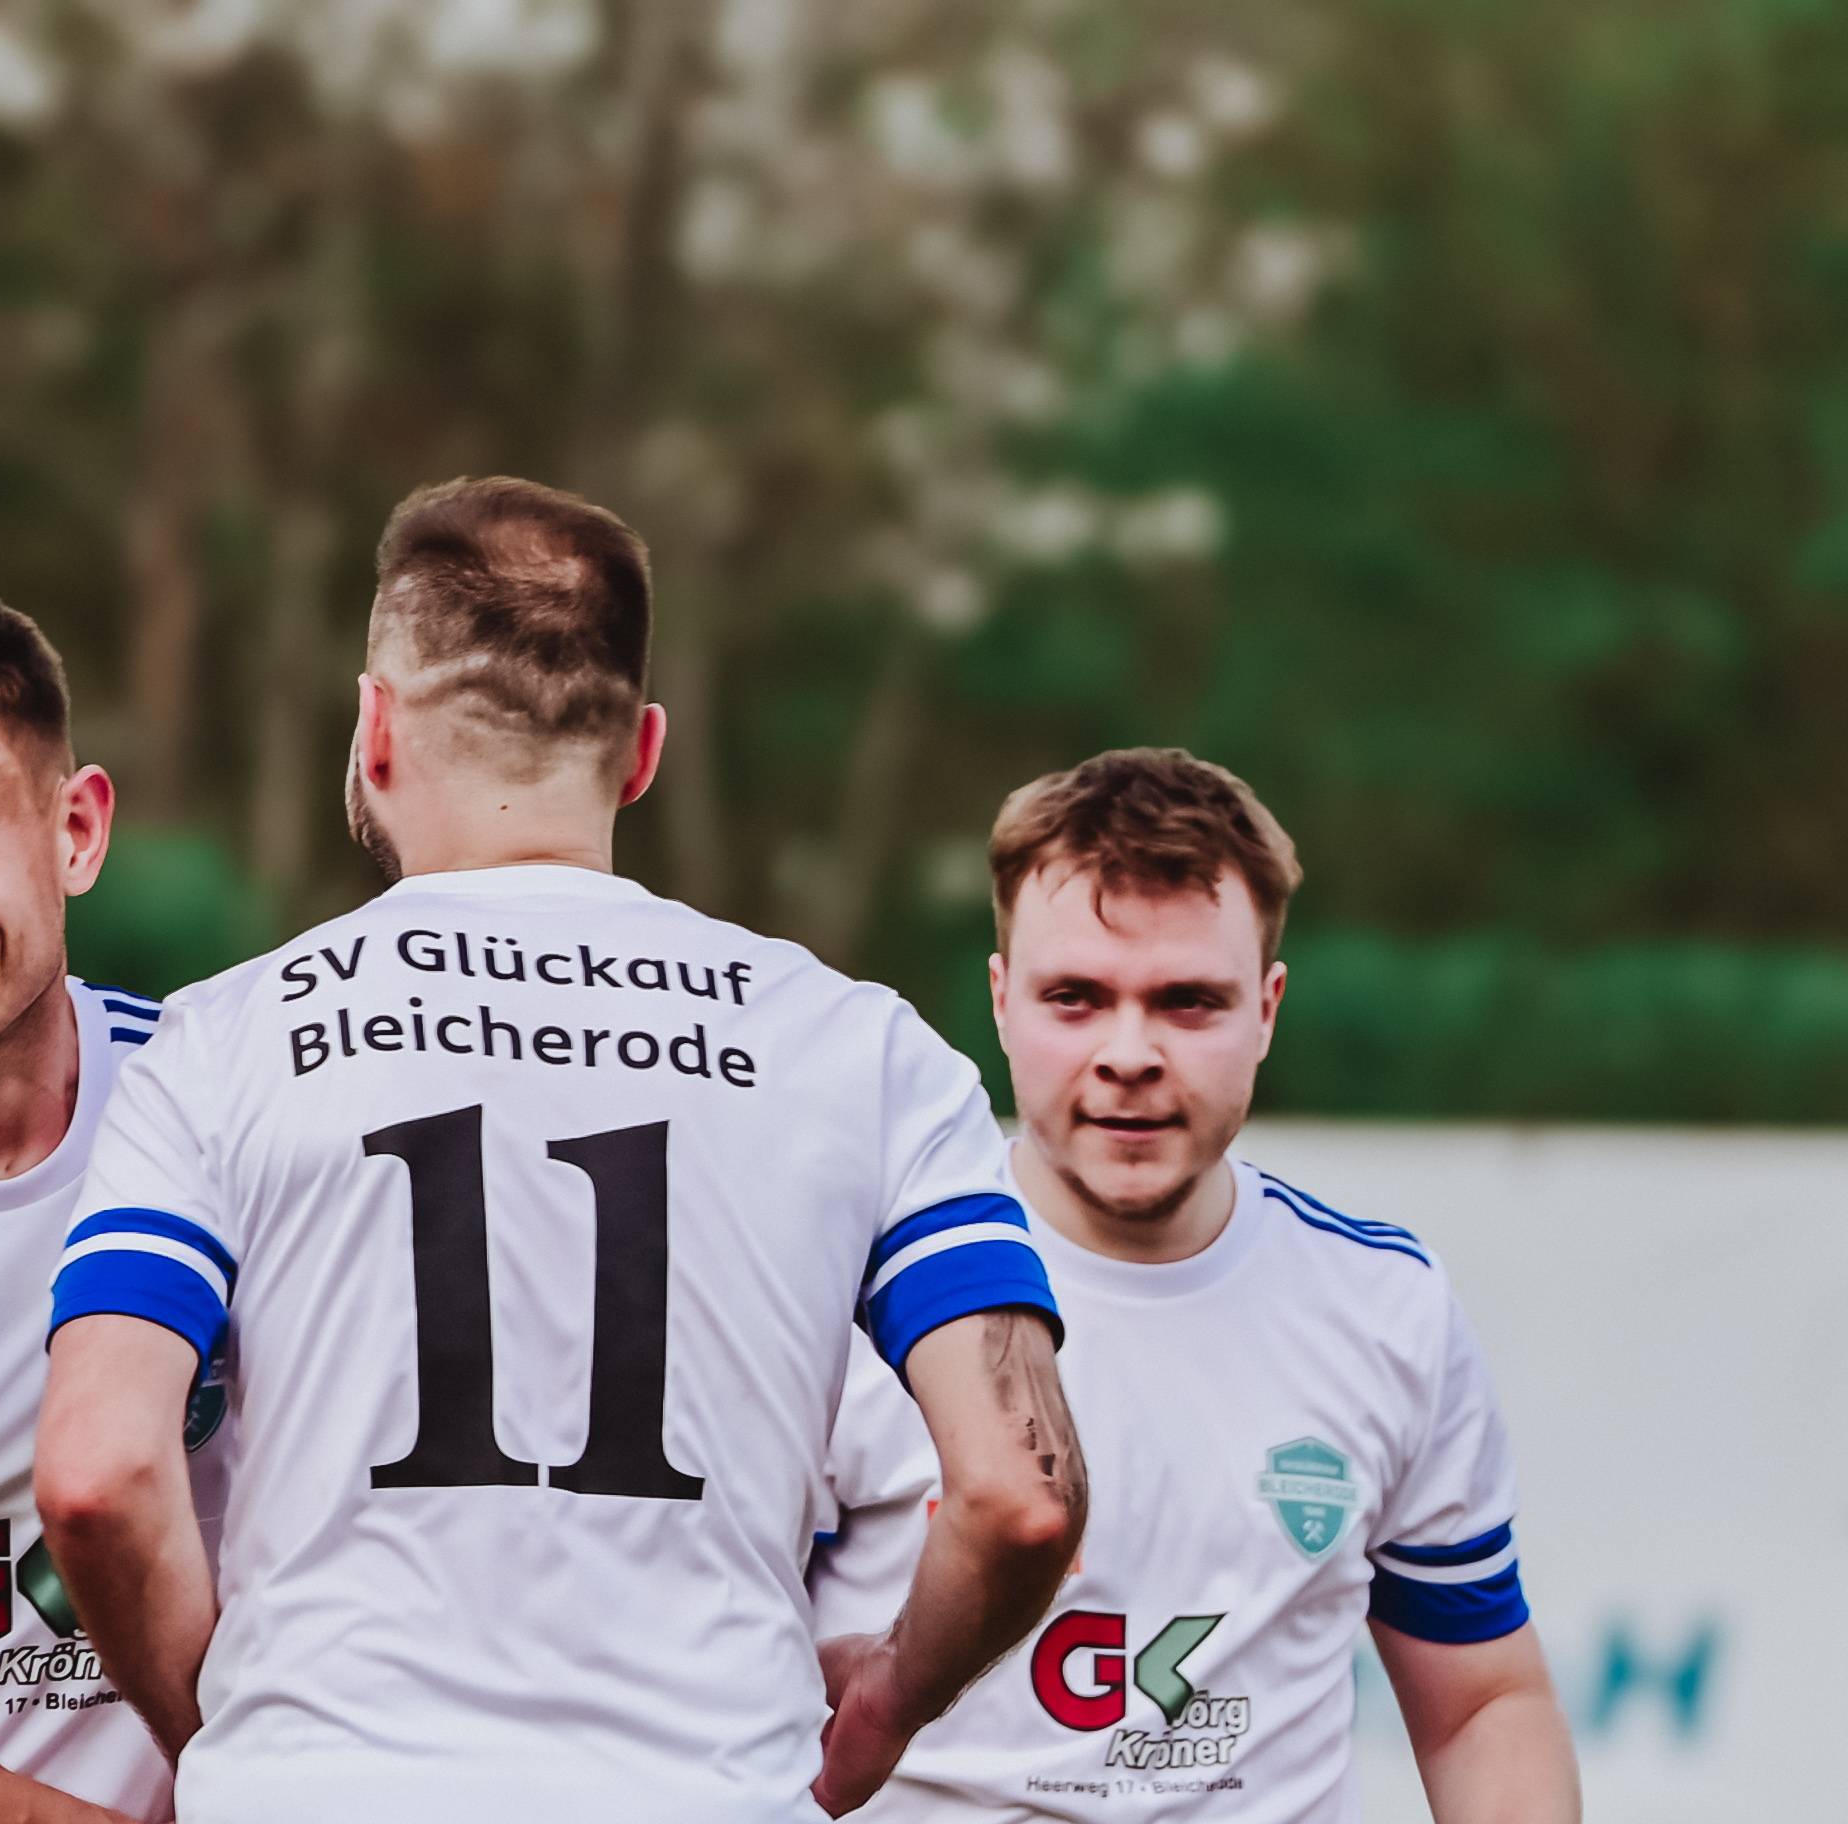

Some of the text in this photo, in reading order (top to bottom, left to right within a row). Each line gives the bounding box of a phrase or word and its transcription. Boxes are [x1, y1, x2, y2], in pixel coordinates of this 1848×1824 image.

[281, 929, 752, 1006] SV Glückauf
[290, 997, 757, 1088] Bleicherode
[362, 1103, 706, 1501] 11
[6, 1698, 28, 1714] 17
[1026, 1776, 1109, 1798] Heerweg
[1115, 1780, 1133, 1794] 17
